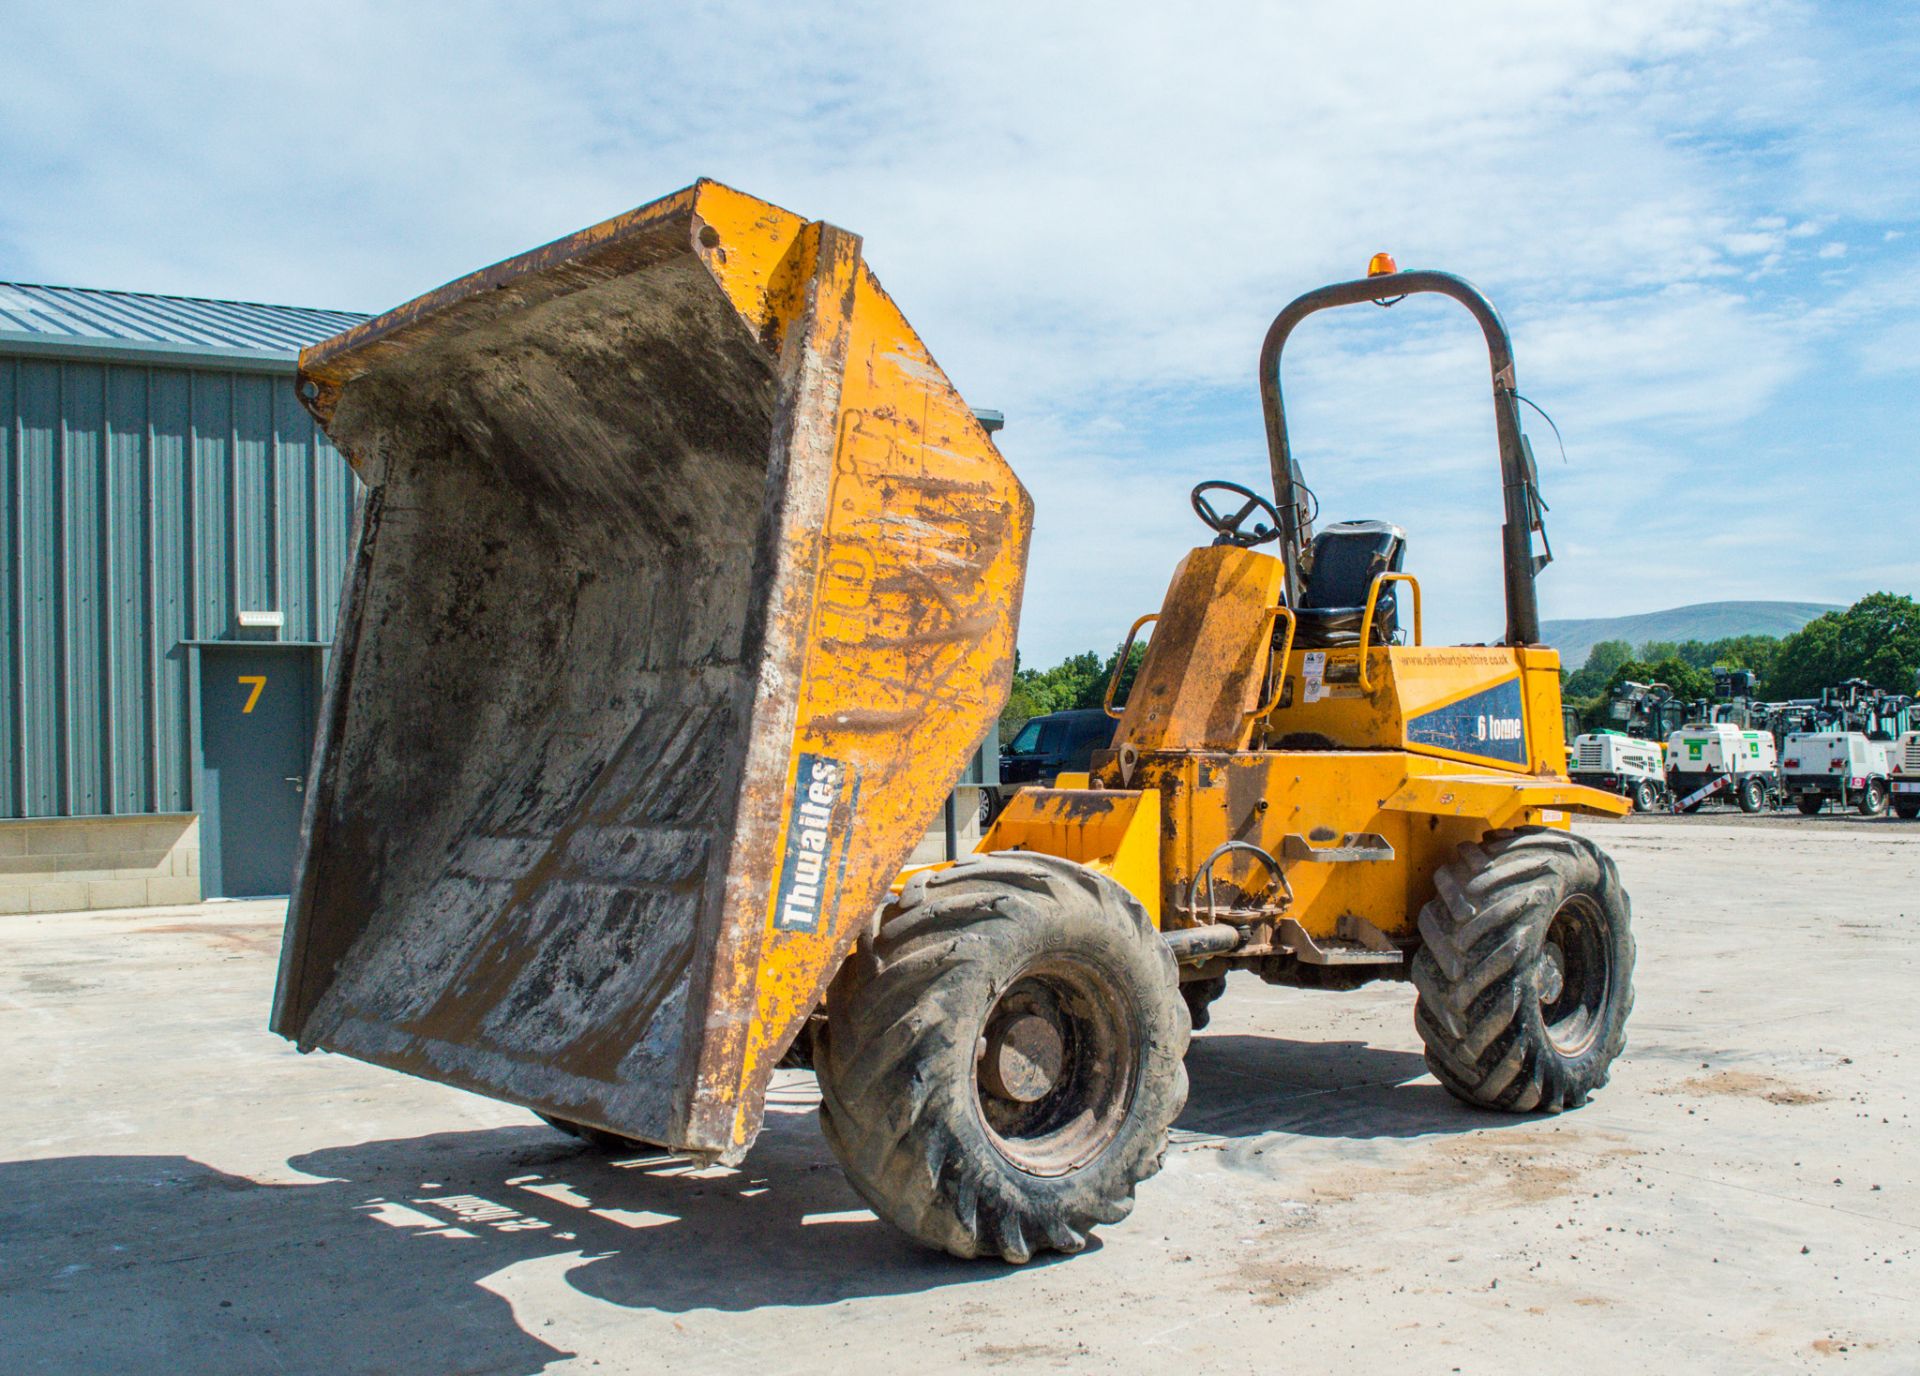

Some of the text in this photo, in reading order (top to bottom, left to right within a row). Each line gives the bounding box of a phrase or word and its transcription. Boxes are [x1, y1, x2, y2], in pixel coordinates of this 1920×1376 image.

[238, 675, 267, 715] 7
[1478, 714, 1521, 741] 6 tonne
[781, 762, 837, 924] Thwaites
